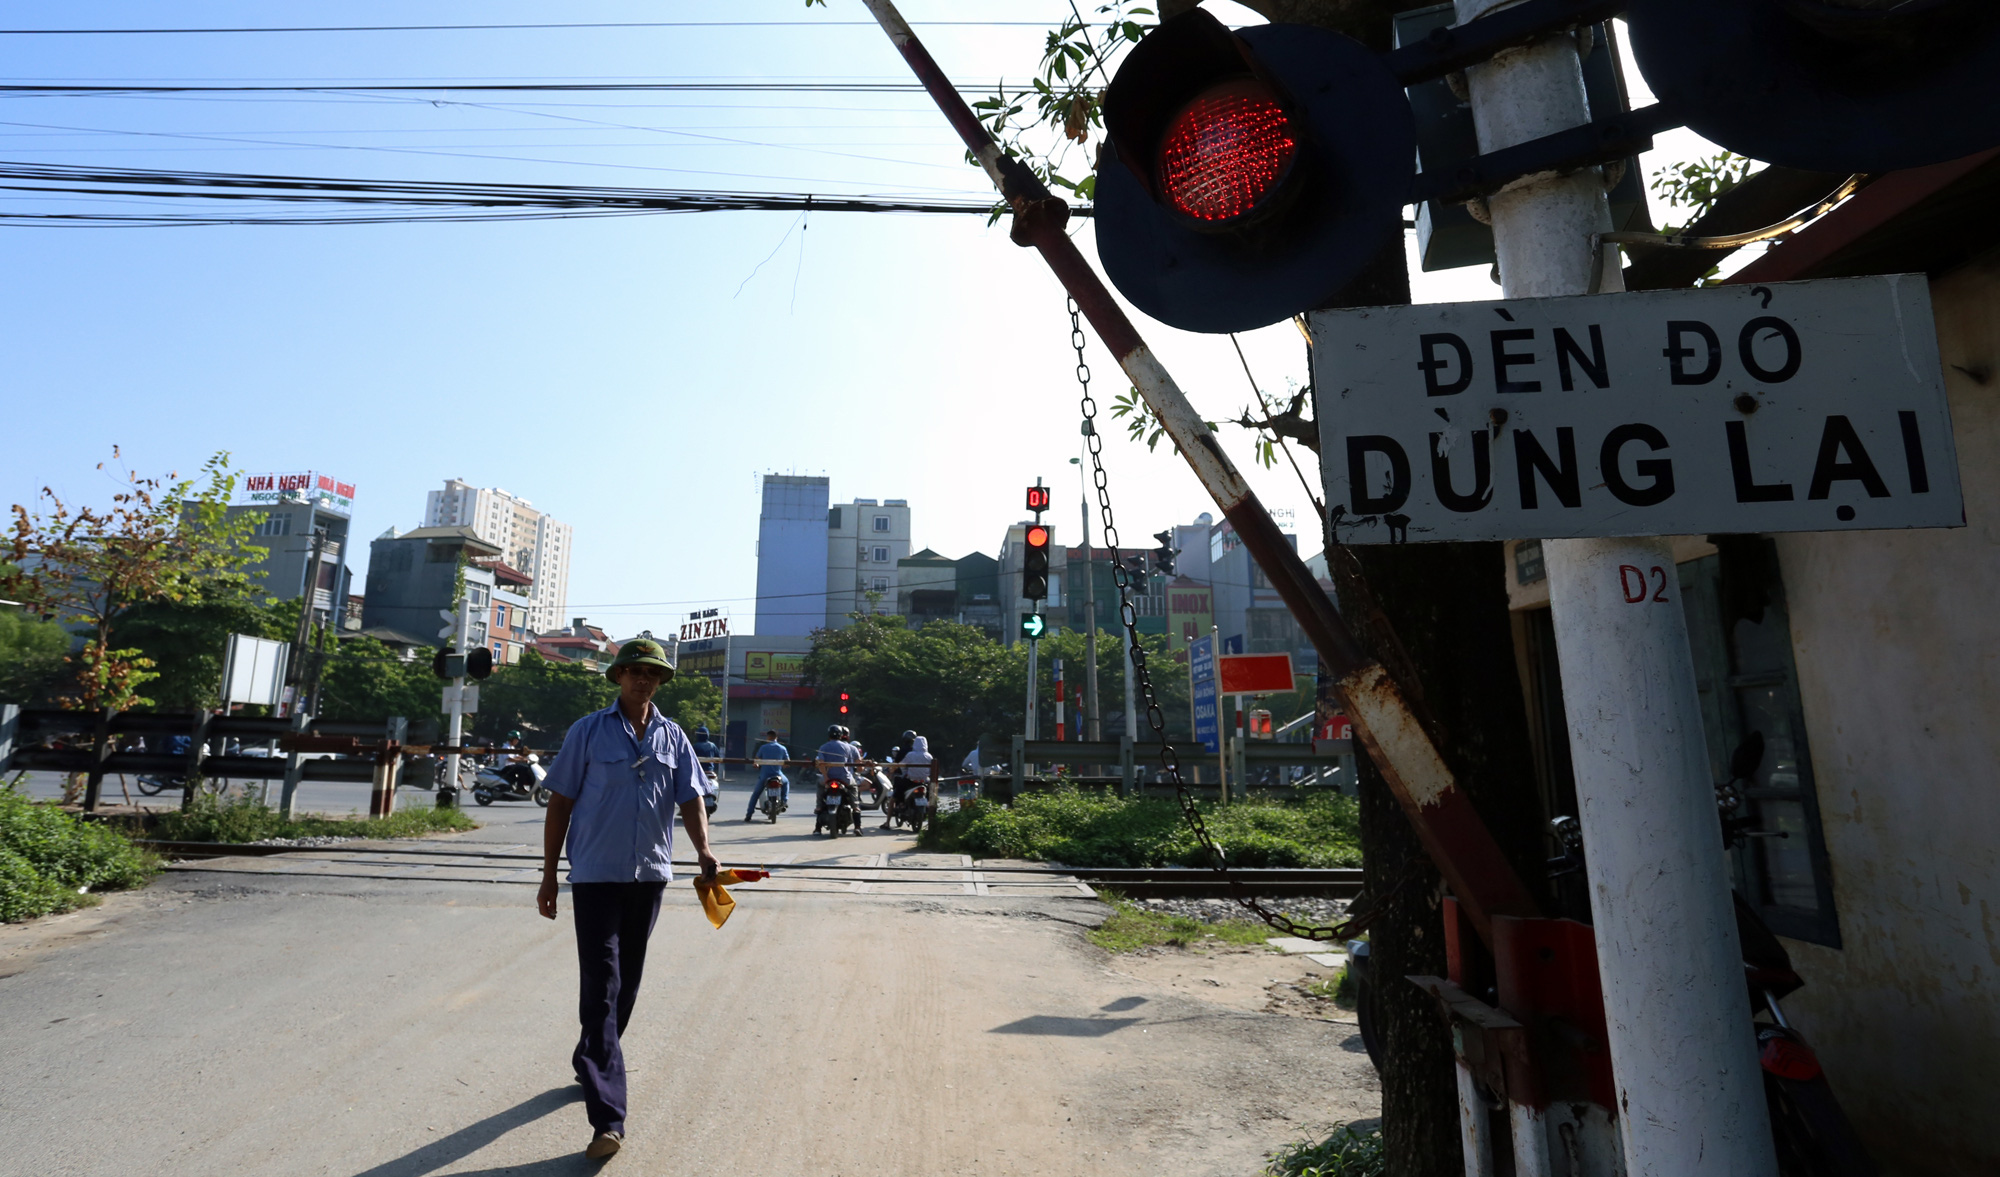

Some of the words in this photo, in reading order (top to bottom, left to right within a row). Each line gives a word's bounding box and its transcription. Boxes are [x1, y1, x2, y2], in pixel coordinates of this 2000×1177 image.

[1417, 308, 1610, 397] ĐÈN
[1662, 286, 1802, 386] ĐỎ
[1725, 410, 1930, 521] LẠI
[1029, 490, 1049, 507] 01
[1619, 564, 1670, 604] D2
[1172, 593, 1209, 615] INOX
[680, 622, 702, 641] ZIN
[704, 618, 728, 639] ZIN
[1195, 704, 1216, 720] OSAKA
